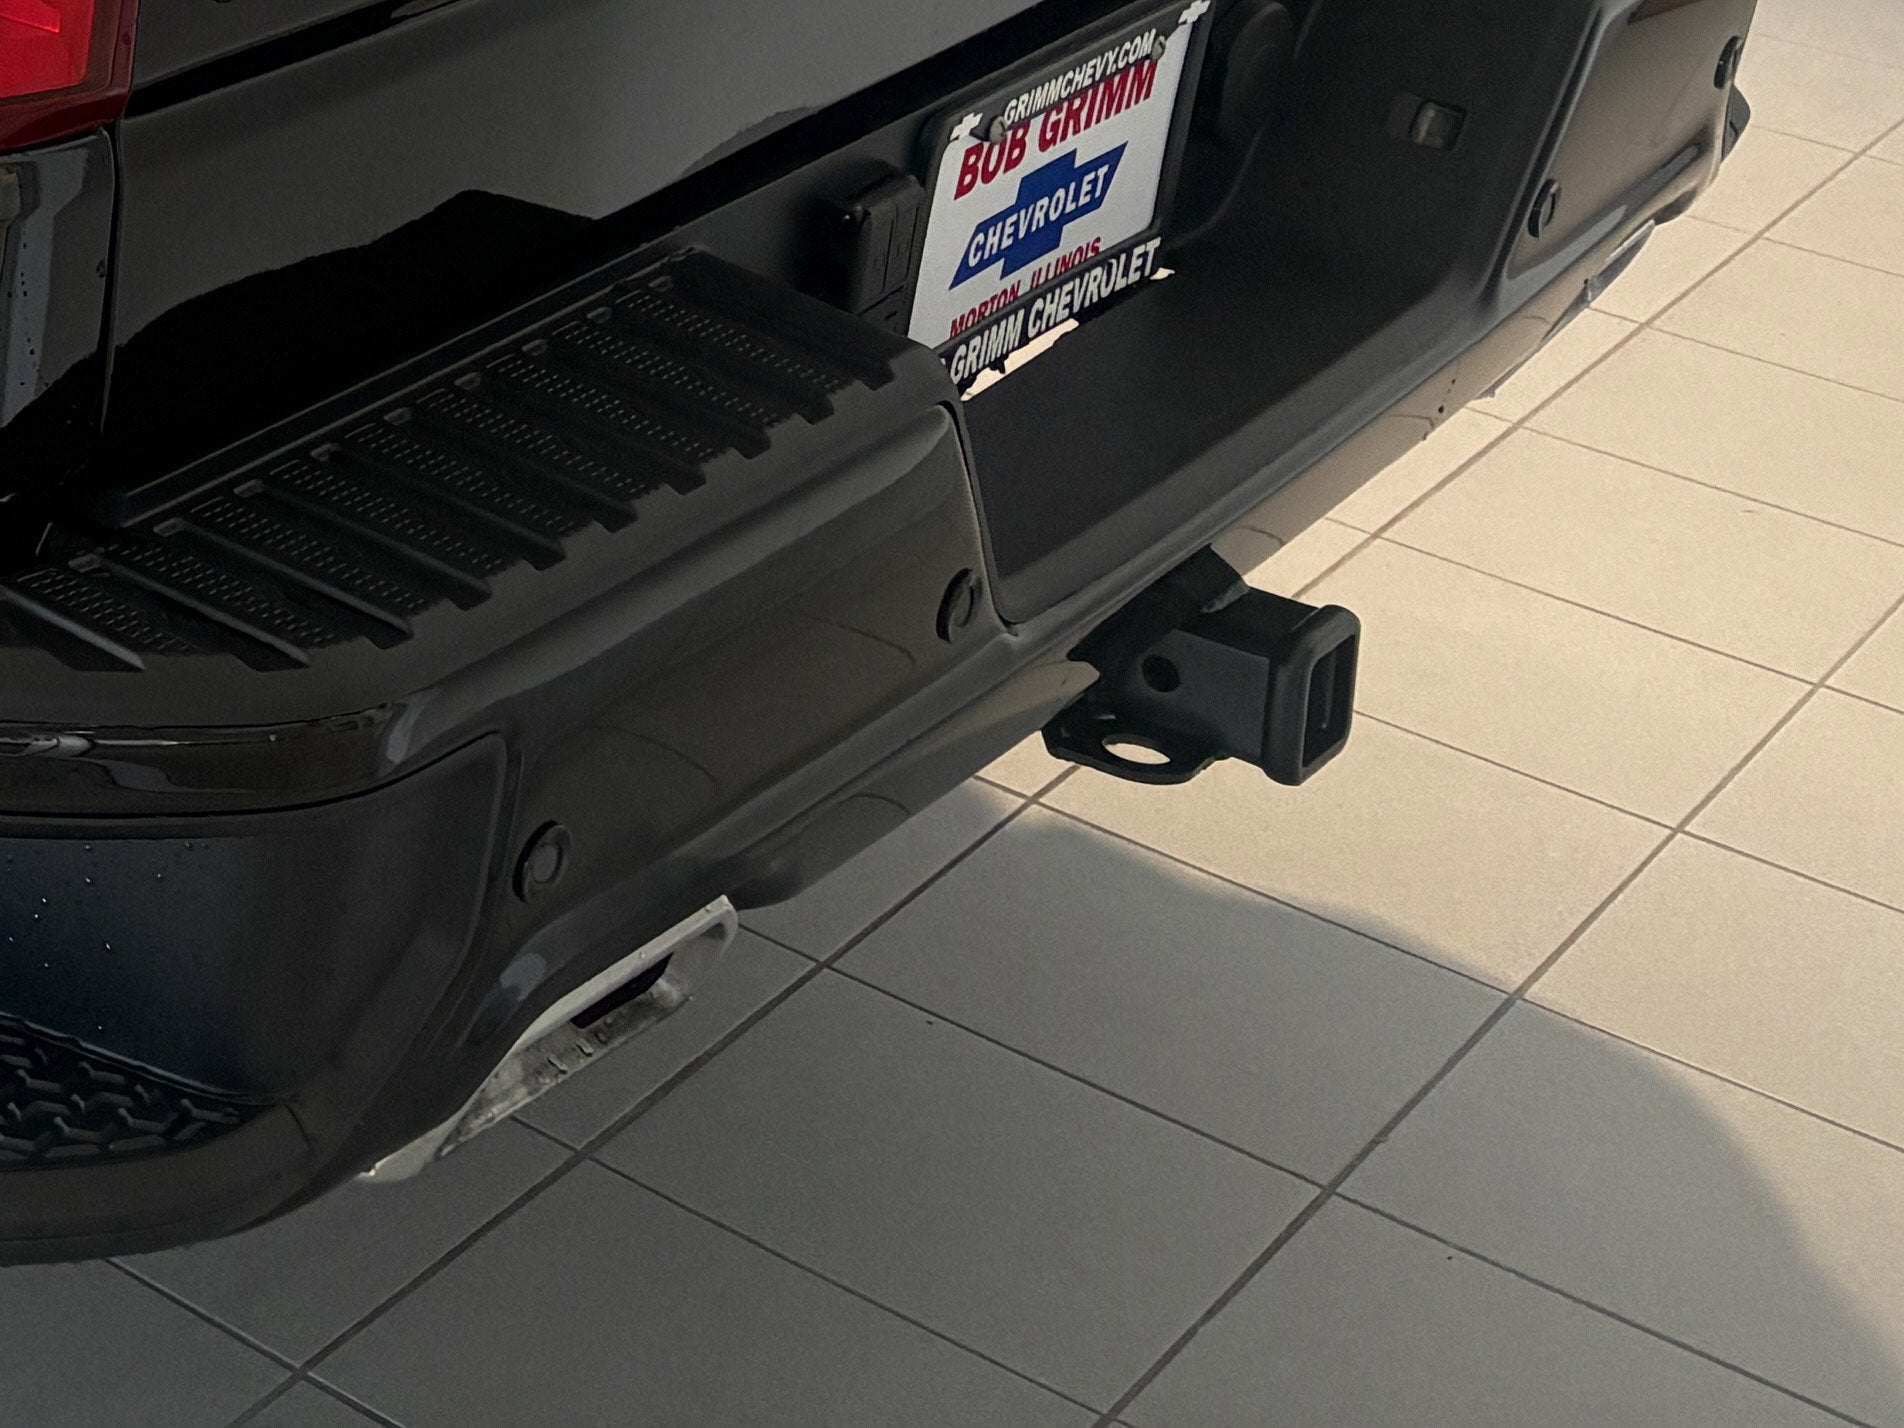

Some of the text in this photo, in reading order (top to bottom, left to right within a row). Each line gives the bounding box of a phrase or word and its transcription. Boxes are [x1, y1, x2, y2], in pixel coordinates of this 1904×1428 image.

[1003, 28, 1157, 124] GRIMMCHEVY.COM
[954, 59, 1159, 200] BOB GRIMM
[968, 164, 1111, 267] CHEVROLET
[950, 236, 1101, 340] MORTON ILLINOIS
[950, 238, 1161, 385] GRIMM CHEVROLET
